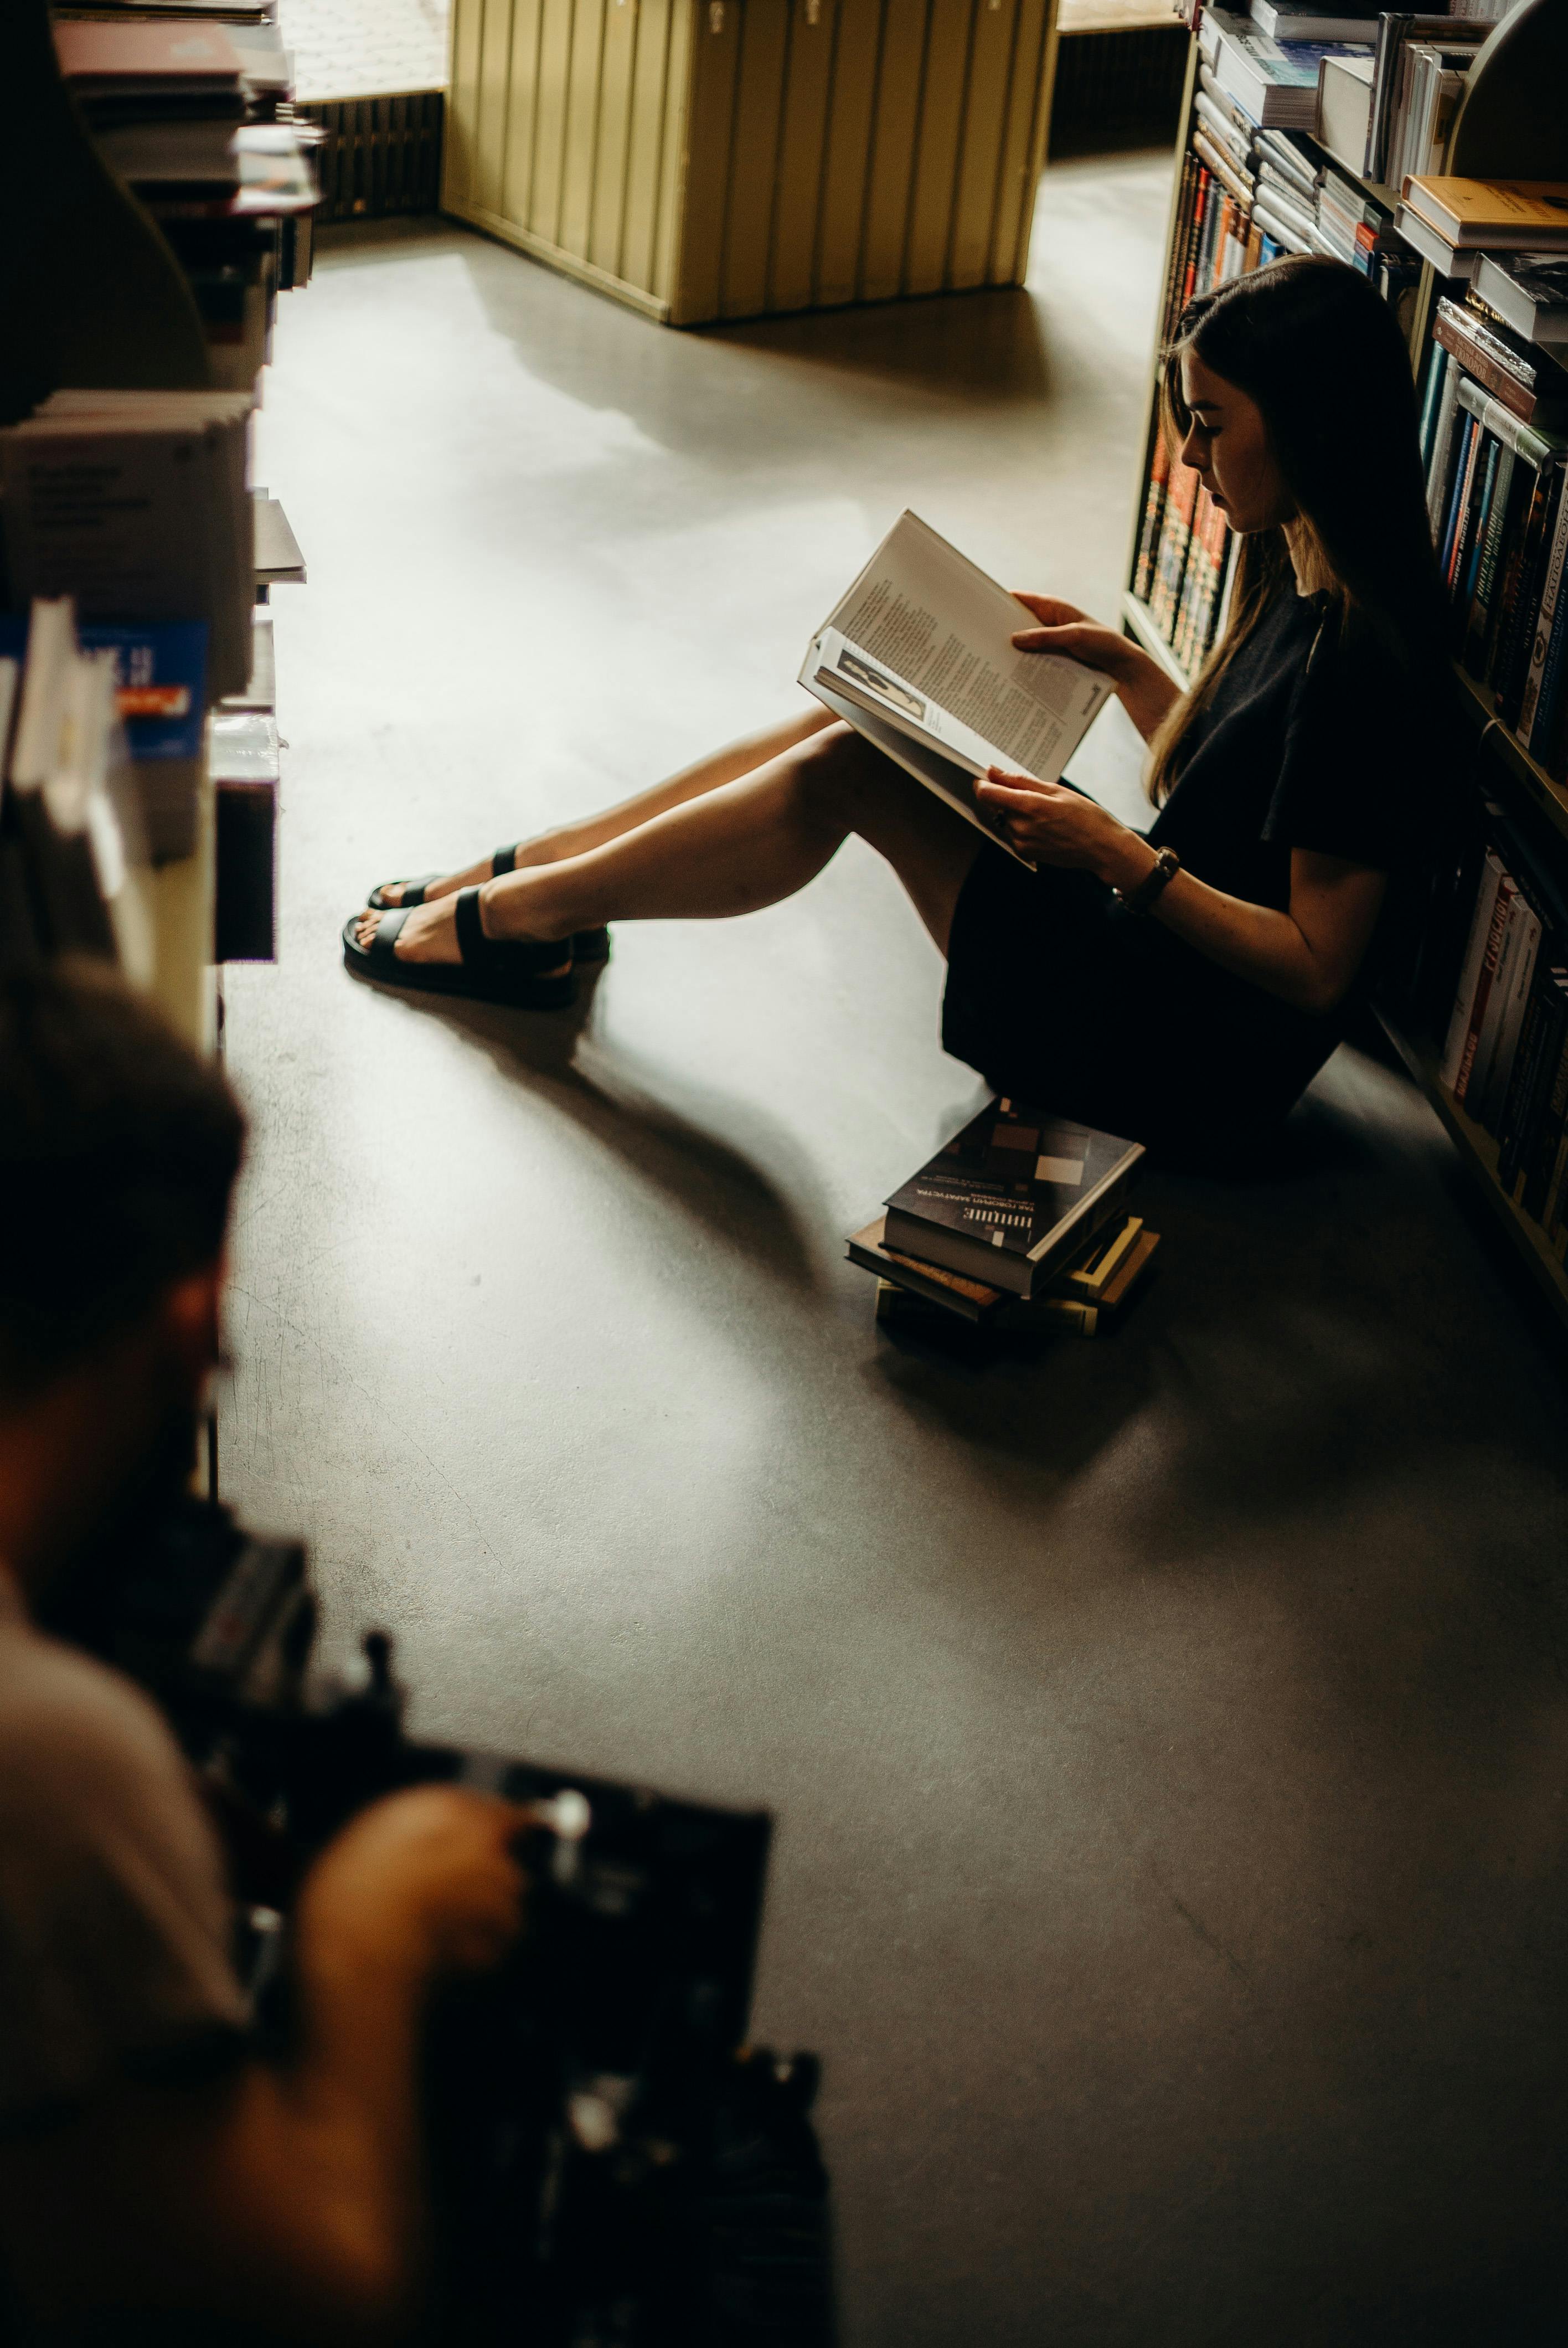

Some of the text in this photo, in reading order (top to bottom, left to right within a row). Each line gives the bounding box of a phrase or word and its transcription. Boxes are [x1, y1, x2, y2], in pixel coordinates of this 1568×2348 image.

[1456, 345, 1486, 380] ТЮДОРОВ
[1459, 505, 1471, 550] ИСТОРИЯ
[1546, 500, 1568, 611] НАПОЛЕОН
[917, 1188, 1035, 1213] ТАК ГОВОРИЛ ЗАРАТУСТРА
[963, 1207, 1033, 1228] НИЦШЕ
